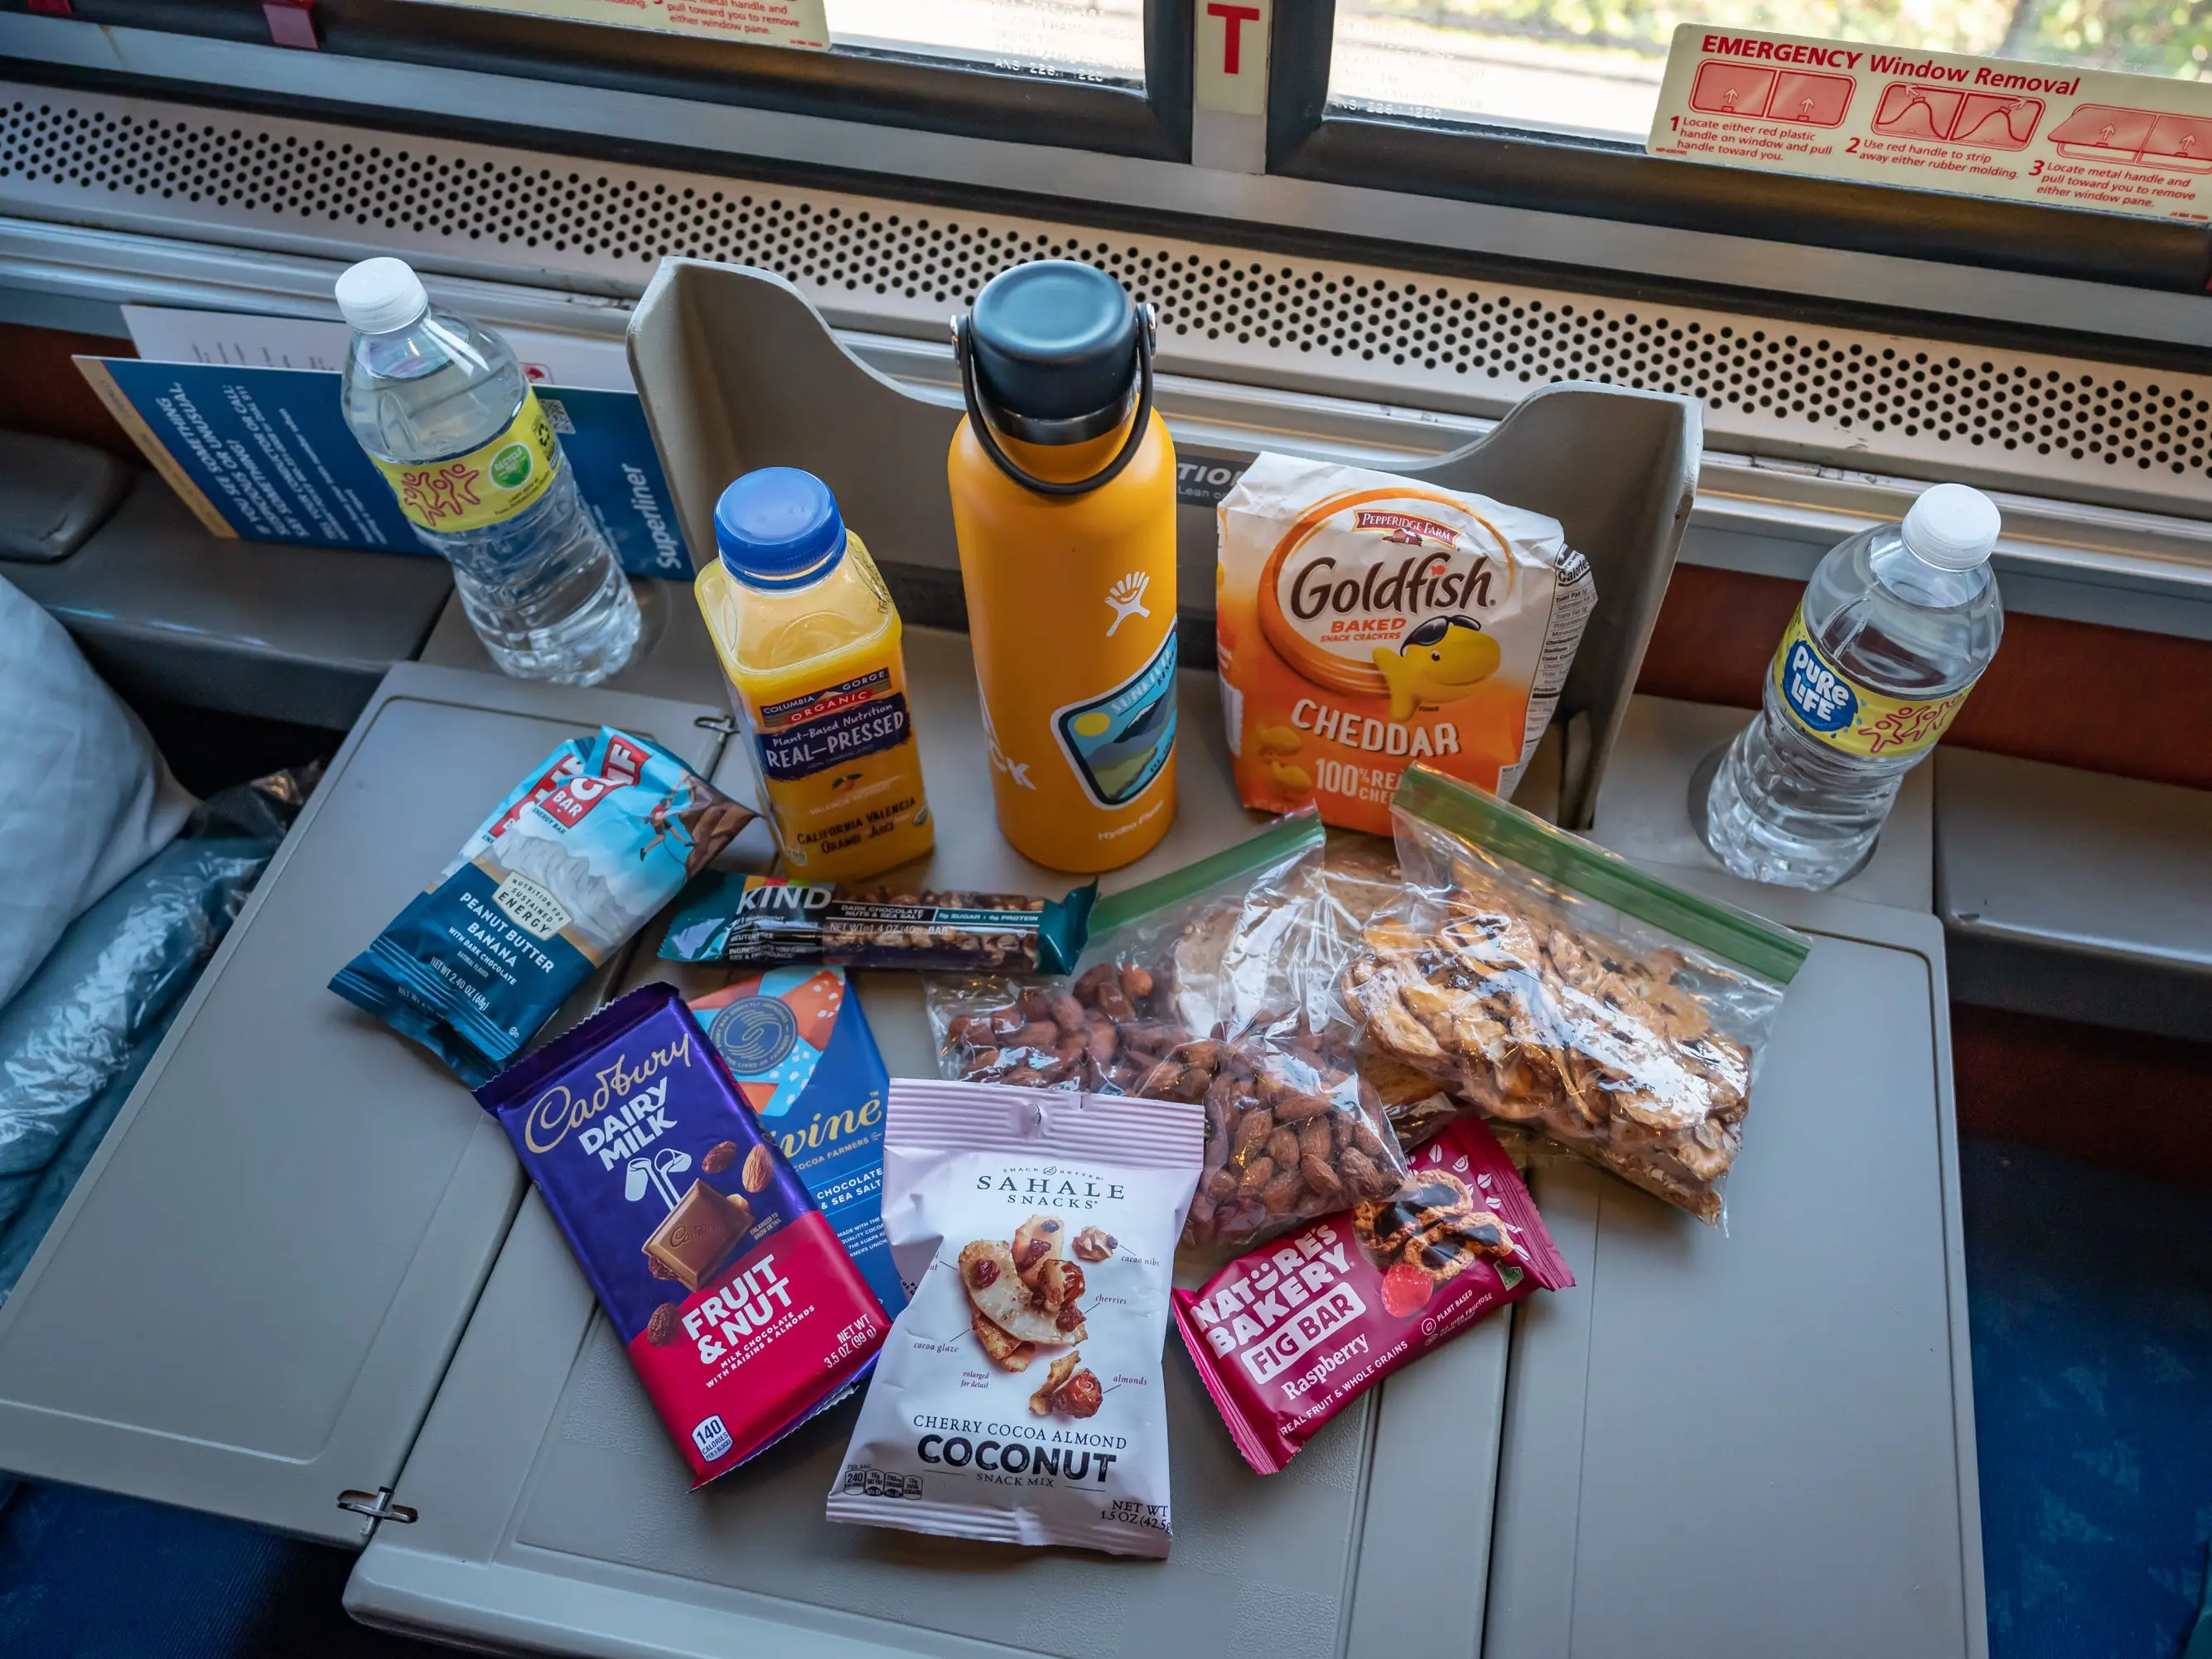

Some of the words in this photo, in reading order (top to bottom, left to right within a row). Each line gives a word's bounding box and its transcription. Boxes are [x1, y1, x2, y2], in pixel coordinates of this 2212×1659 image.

[669, 14, 698, 25] either
[702, 18, 741, 31] window
[689, 5, 725, 17] toward
[762, 16, 800, 27] remove
[1207, 3, 1259, 75] T
[1702, 35, 1862, 70] EMERGENCY
[1871, 55, 1970, 82] Window
[1974, 67, 2081, 95] Removal
[1670, 116, 1679, 132] 1
[1683, 117, 1719, 130] Locate
[1722, 120, 1756, 133] either
[1758, 124, 1777, 137] red
[1780, 128, 1815, 141] plastic
[1680, 128, 1717, 141] handle
[1721, 135, 1735, 143] on
[1739, 136, 1783, 149] window
[1786, 141, 1807, 152] and
[1809, 145, 1833, 156] pull
[1677, 139, 1714, 152] handle
[1718, 144, 1757, 157] toward
[1759, 151, 1783, 161] you.
[1846, 137, 1861, 154] 2
[1864, 139, 1883, 149] Use
[1886, 142, 1906, 152] red
[1909, 144, 1948, 157] handle
[1951, 151, 1963, 159] to
[1966, 152, 1991, 164] strip
[1859, 151, 1889, 164] away
[1891, 155, 1924, 166] either
[1928, 159, 1966, 172] rubber
[1969, 165, 2020, 180] molding.
[2029, 160, 2045, 176] 3
[2047, 162, 2084, 175] Locate
[2088, 166, 2121, 179] metal
[2124, 171, 2164, 184] handle
[2166, 177, 2191, 187] and
[2036, 185, 2071, 197] either
[2074, 189, 2119, 203] window
[2122, 196, 2154, 207] pane.
[2041, 173, 2064, 183] pull
[2067, 176, 2108, 190] toward
[2110, 183, 2133, 193] you
[2137, 186, 2149, 195] to
[2152, 188, 2195, 200] remove
[1178, 485, 1210, 498] Lean
[621, 463, 682, 570] Superliner
[1362, 513, 1422, 532] PEPPERIDGE
[1423, 523, 1451, 540] FARM
[1290, 551, 1494, 621] Goldfish
[1320, 634, 1351, 644] SNACK
[1354, 631, 1402, 642] CRACKERS
[1331, 617, 1407, 634] BAKED
[763, 695, 815, 715] COLUMBIA
[843, 670, 886, 691] GORGE
[790, 690, 868, 722] ORGANIC
[772, 721, 840, 748] Plant-Based
[843, 703, 893, 727] Nutrition
[1291, 698, 1461, 758] CHEDDAR
[552, 790, 583, 817] BAR
[532, 808, 553, 825] ENERGY
[553, 823, 567, 836] BAR
[797, 817, 864, 845] CALIFORNIA
[866, 795, 917, 823] VALENCIA
[497, 890, 551, 933] ENERGY
[510, 887, 553, 924] SUSTAINED
[512, 879, 552, 908] NUTRITION
[552, 907, 564, 922] FOR
[736, 885, 833, 915] KIND
[841, 904, 866, 913] DARK
[868, 905, 925, 916] CHOCOLATE
[460, 892, 509, 933] PEANUT
[505, 928, 555, 974] BUTTER
[466, 922, 518, 968] BANANA
[927, 926, 949, 935] BAR
[448, 927, 466, 943] WITH
[464, 939, 482, 957] DARK
[481, 952, 517, 986] CHOCOLATE
[430, 956, 442, 972] NET
[448, 972, 466, 990] 2.40
[465, 984, 476, 998] OZ
[472, 991, 490, 1012] (68g)
[524, 1033, 692, 1154] Cadbury
[578, 1076, 668, 1156] DAIRY
[775, 1098, 882, 1160] vine
[598, 1107, 678, 1172] MILK
[826, 1136, 870, 1160] FARMERS
[816, 1167, 883, 1200] CHOCOLATE
[821, 1201, 828, 1210] &
[831, 1192, 853, 1207] SEA
[856, 1179, 881, 1196] SALT
[977, 1174, 1125, 1200] SAHALE
[1007, 1194, 1098, 1209] SNACKS
[1120, 1254, 1142, 1266] cacao
[1144, 1256, 1161, 1267] nibs
[682, 1253, 779, 1341] FRUIT
[720, 1277, 792, 1347] NUT
[1095, 1294, 1128, 1305] cherries
[1206, 1242, 1350, 1359] BAKERY
[1437, 1304, 1456, 1323] PLANT
[1454, 1289, 1473, 1308] BASED
[721, 1350, 743, 1369] MILK
[745, 1311, 794, 1352] CHOCOLATE
[837, 1324, 855, 1344] NET
[853, 1314, 871, 1329] WT
[1252, 1332, 1300, 1375] FIG
[1297, 1293, 1355, 1342] BAR
[706, 1368, 731, 1389] WITH
[730, 1343, 766, 1371] RAISINS
[766, 1336, 774, 1344] &
[775, 1305, 816, 1338] ALMONDS
[823, 1353, 840, 1369] 3.5
[838, 1343, 853, 1358] OZ
[851, 1331, 867, 1349] (99
[913, 1341, 935, 1351] cocoa
[937, 1343, 959, 1354] glaze
[963, 1370, 990, 1380] enlarged
[1113, 1372, 1148, 1386] almonds
[1282, 1333, 1370, 1401] Raspberry
[960, 1379, 969, 1389] for
[970, 1380, 989, 1390] detail
[1279, 1415, 1306, 1436] REAL
[1306, 1395, 1334, 1419] FRUIT
[1334, 1388, 1343, 1398] &
[1341, 1364, 1375, 1391] WHOLE
[1374, 1340, 1409, 1368] GRAINS
[697, 1419, 722, 1444] 140
[701, 1432, 729, 1455] CALORIES
[914, 1415, 983, 1434] CHERRY
[988, 1423, 1047, 1442] COCOA
[1050, 1430, 1128, 1449] ALMOND
[917, 1434, 1117, 1483] COCONUT
[847, 1472, 863, 1483] 240
[976, 1472, 1023, 1487] SNACK
[1026, 1476, 1055, 1488] MIX
[1112, 1499, 1143, 1514] NET
[1146, 1504, 1168, 1517] WT
[1118, 1512, 1139, 1524] OZ
